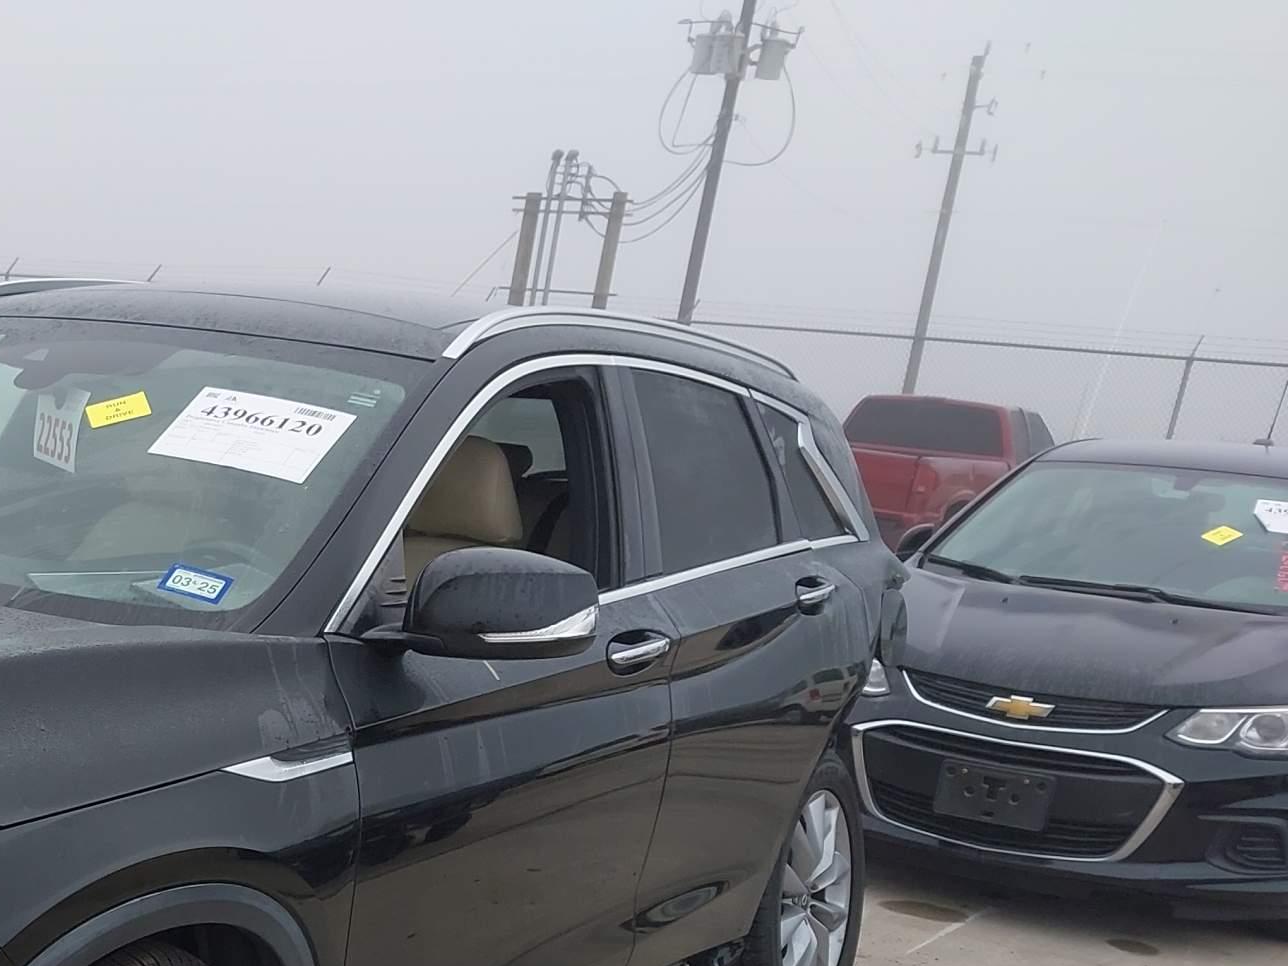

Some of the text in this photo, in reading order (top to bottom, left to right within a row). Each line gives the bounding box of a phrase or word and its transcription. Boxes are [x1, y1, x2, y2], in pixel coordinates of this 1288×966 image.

[200, 404, 323, 437] 43966120
[35, 412, 74, 464] 22553
[172, 574, 219, 594] 03 25
